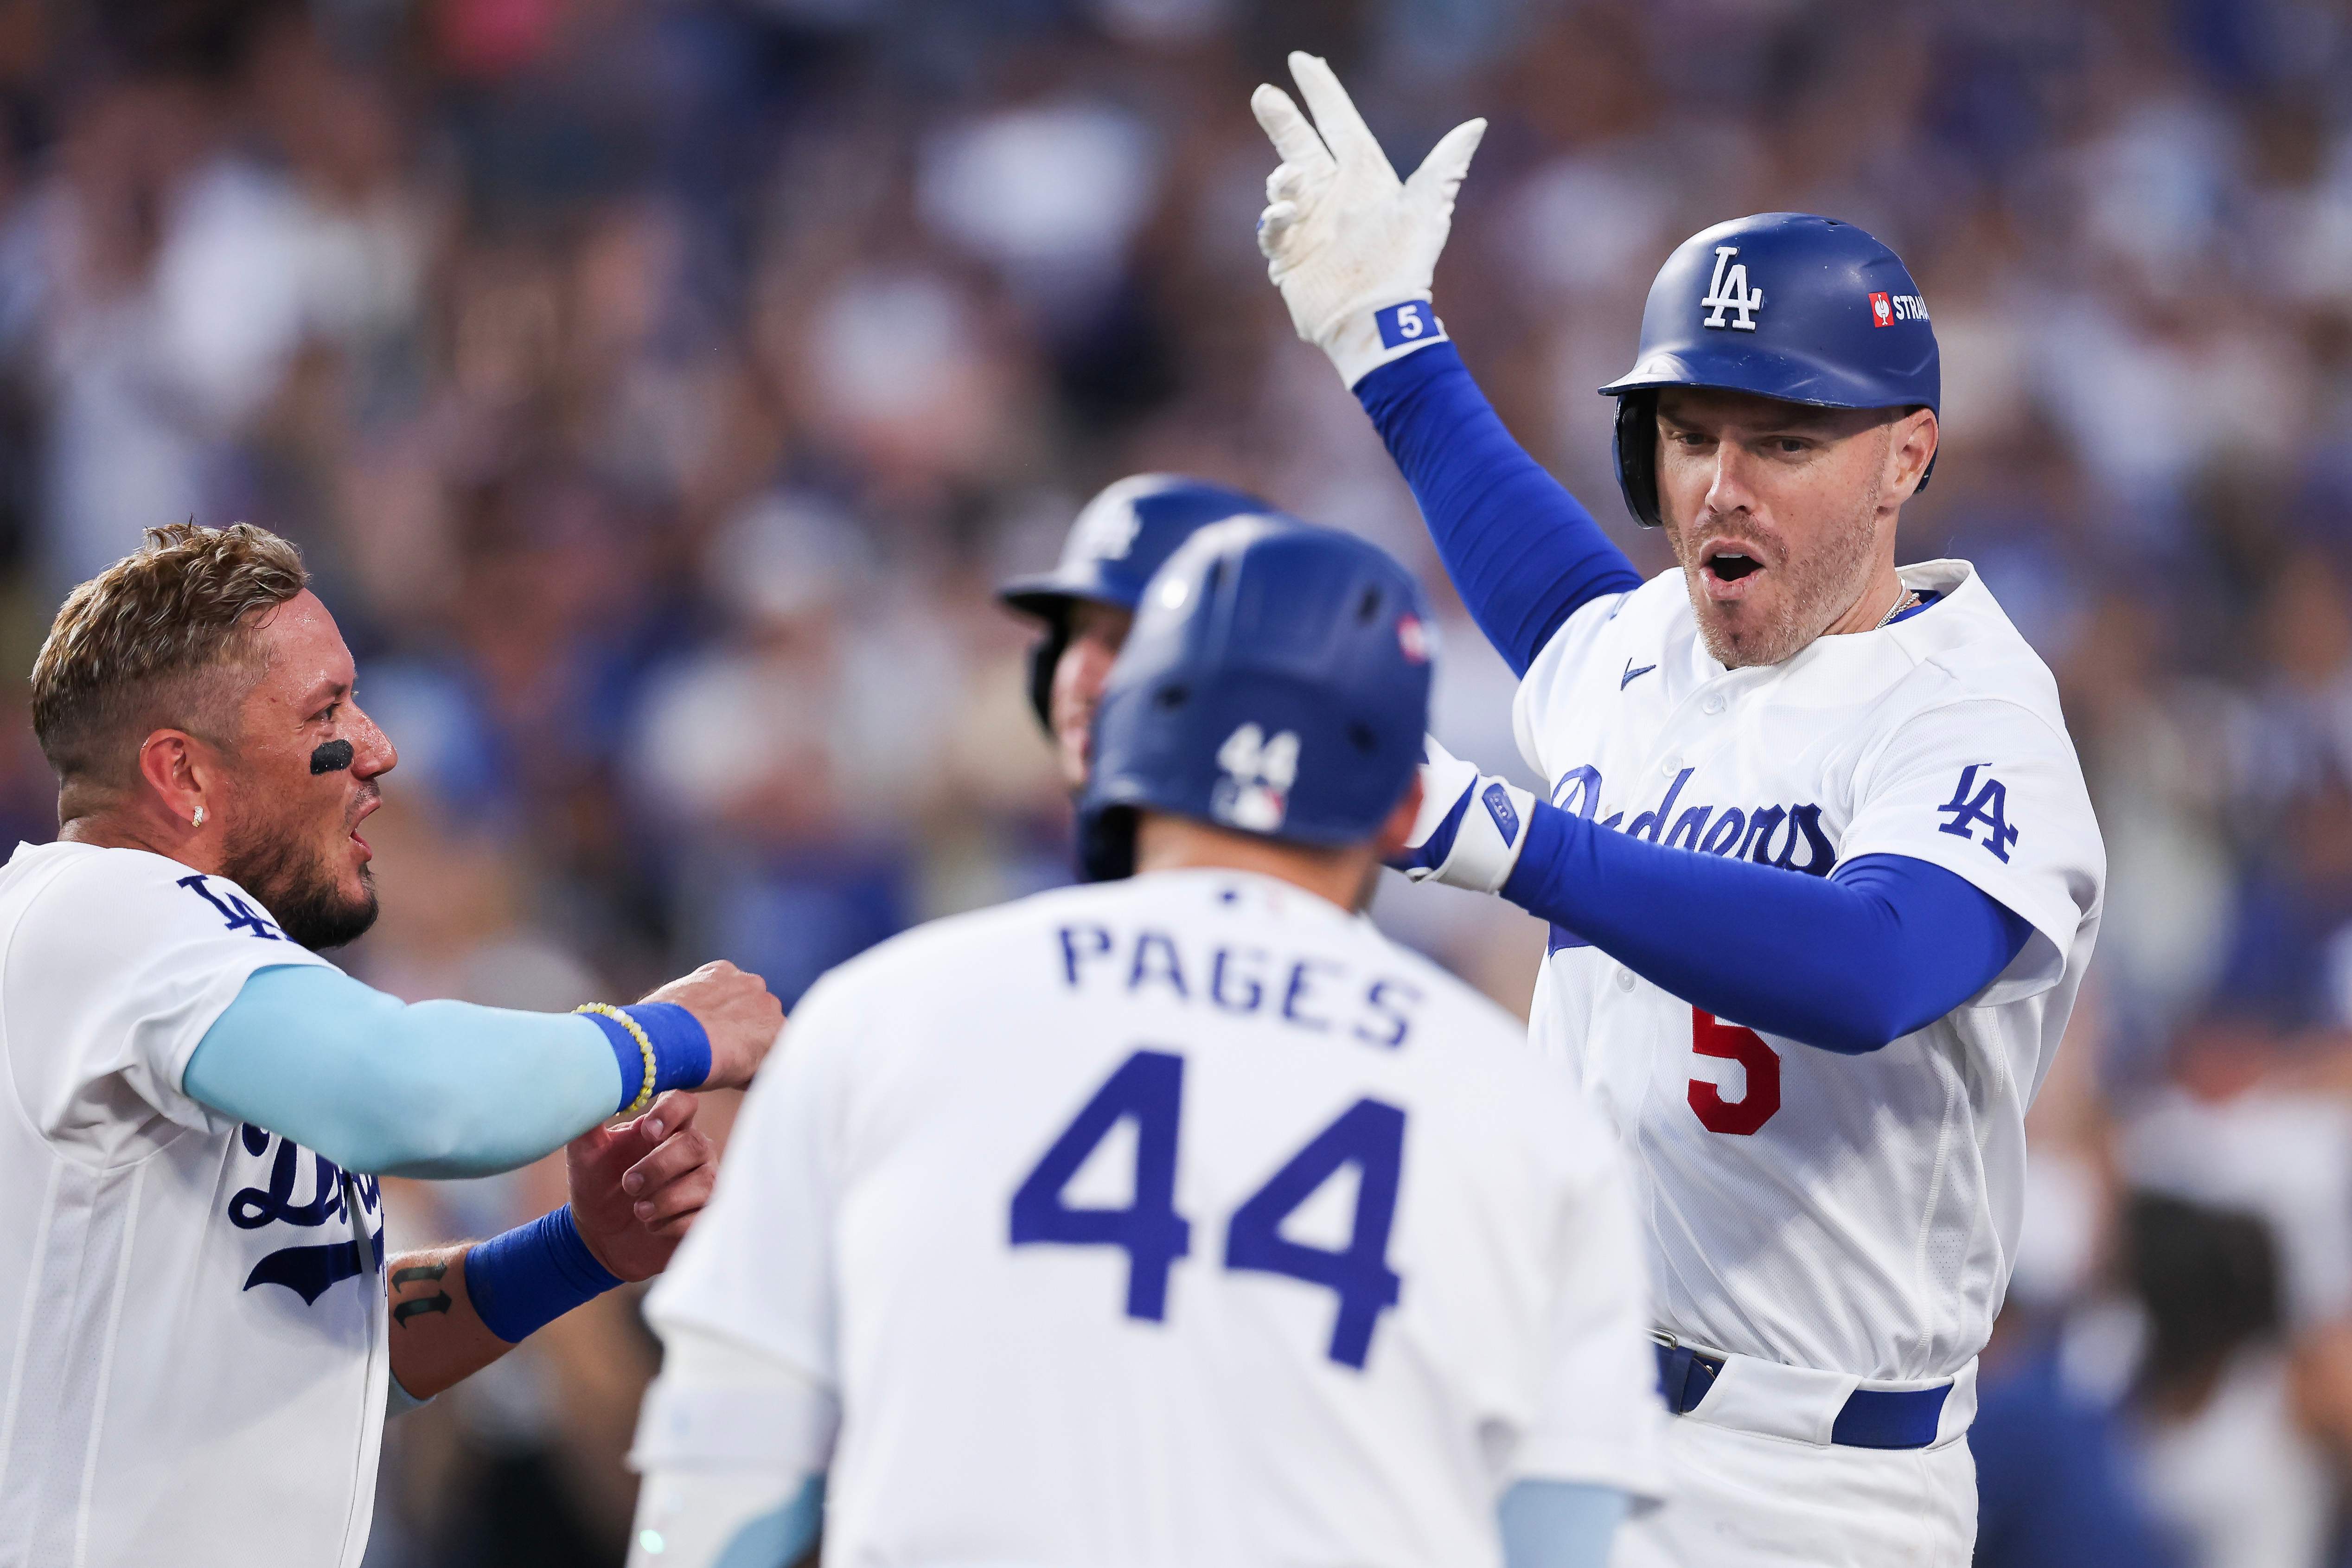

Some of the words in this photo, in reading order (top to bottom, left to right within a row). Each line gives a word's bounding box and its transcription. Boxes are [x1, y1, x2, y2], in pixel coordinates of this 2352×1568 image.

[1397, 304, 1424, 339] 5
[1701, 246, 1763, 331] LA
[1214, 722, 1301, 792] 44
[1937, 763, 2019, 864] LA
[1057, 925, 1425, 1050] PAGES
[1687, 1005, 1781, 1136] 5
[1009, 1049, 1406, 1371] 44
